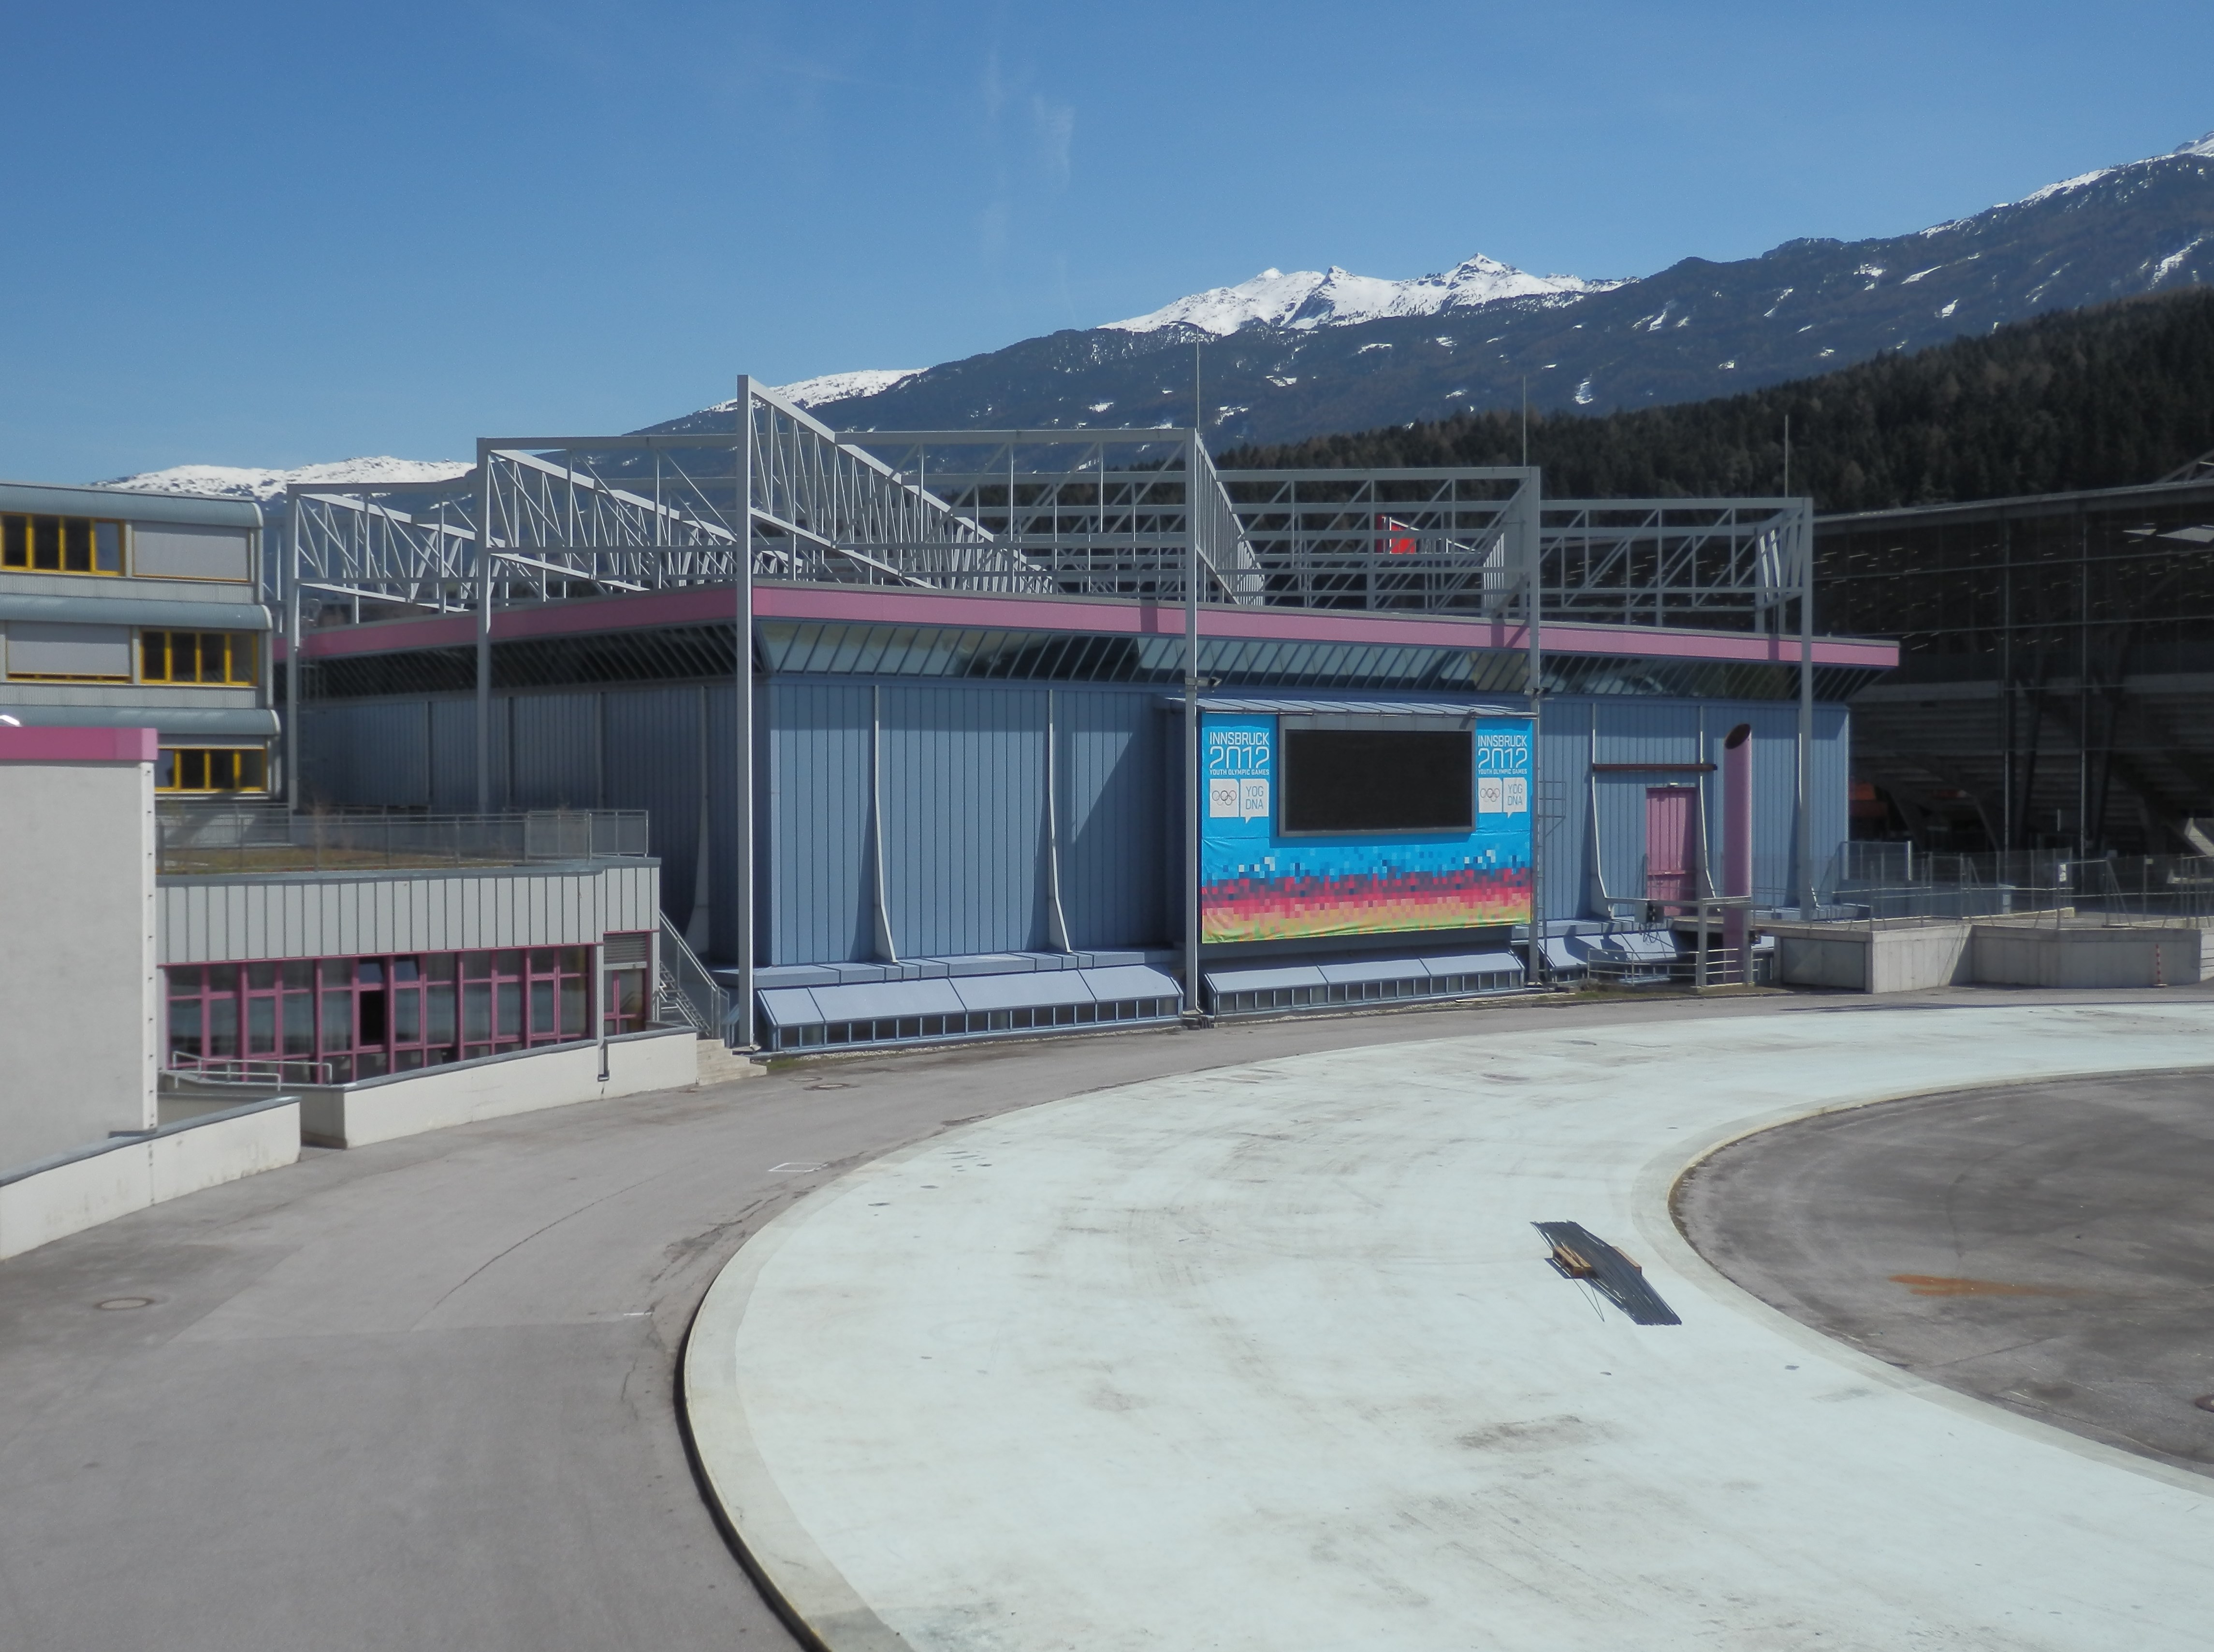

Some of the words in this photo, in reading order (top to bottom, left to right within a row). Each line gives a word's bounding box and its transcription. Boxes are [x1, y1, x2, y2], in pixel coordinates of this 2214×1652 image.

[1210, 732, 1269, 745] INNSBRUCK
[1478, 735, 1528, 747] INNSBRUCK
[1210, 746, 1269, 768] 2012
[1478, 748, 1528, 768] 2012
[1246, 786, 1264, 797] YOG
[1508, 784, 1522, 794] YOG
[1245, 799, 1264, 810] DNA
[1508, 796, 1522, 806] DNA
